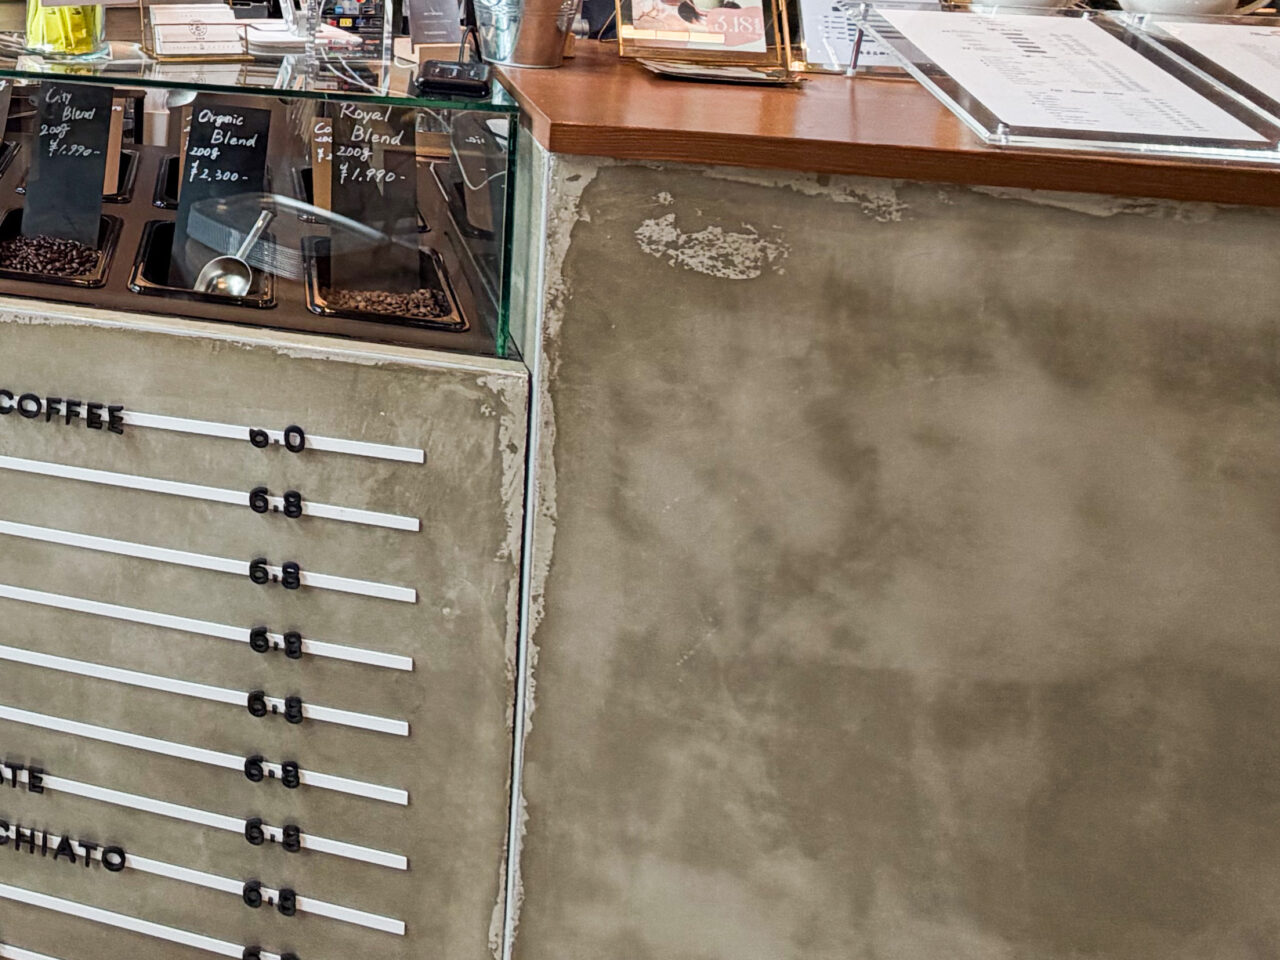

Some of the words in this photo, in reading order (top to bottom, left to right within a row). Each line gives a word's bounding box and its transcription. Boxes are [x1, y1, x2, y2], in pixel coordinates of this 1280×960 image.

[45, 86, 72, 105] City
[62, 105, 96, 121] Blend
[340, 102, 392, 124] Royal
[39, 123, 71, 139] 200g
[210, 129, 258, 148] Blend
[351, 126, 405, 146] Blend
[188, 146, 221, 160] 200g
[336, 146, 373, 162] 200g
[249, 486, 303, 518] 6.8
[249, 557, 301, 589] 6.8
[249, 626, 303, 659] 6.8
[247, 690, 303, 724] 6.8
[244, 755, 300, 789] 6.8
[244, 817, 301, 853] 6.8
[243, 880, 297, 916] 6.8
